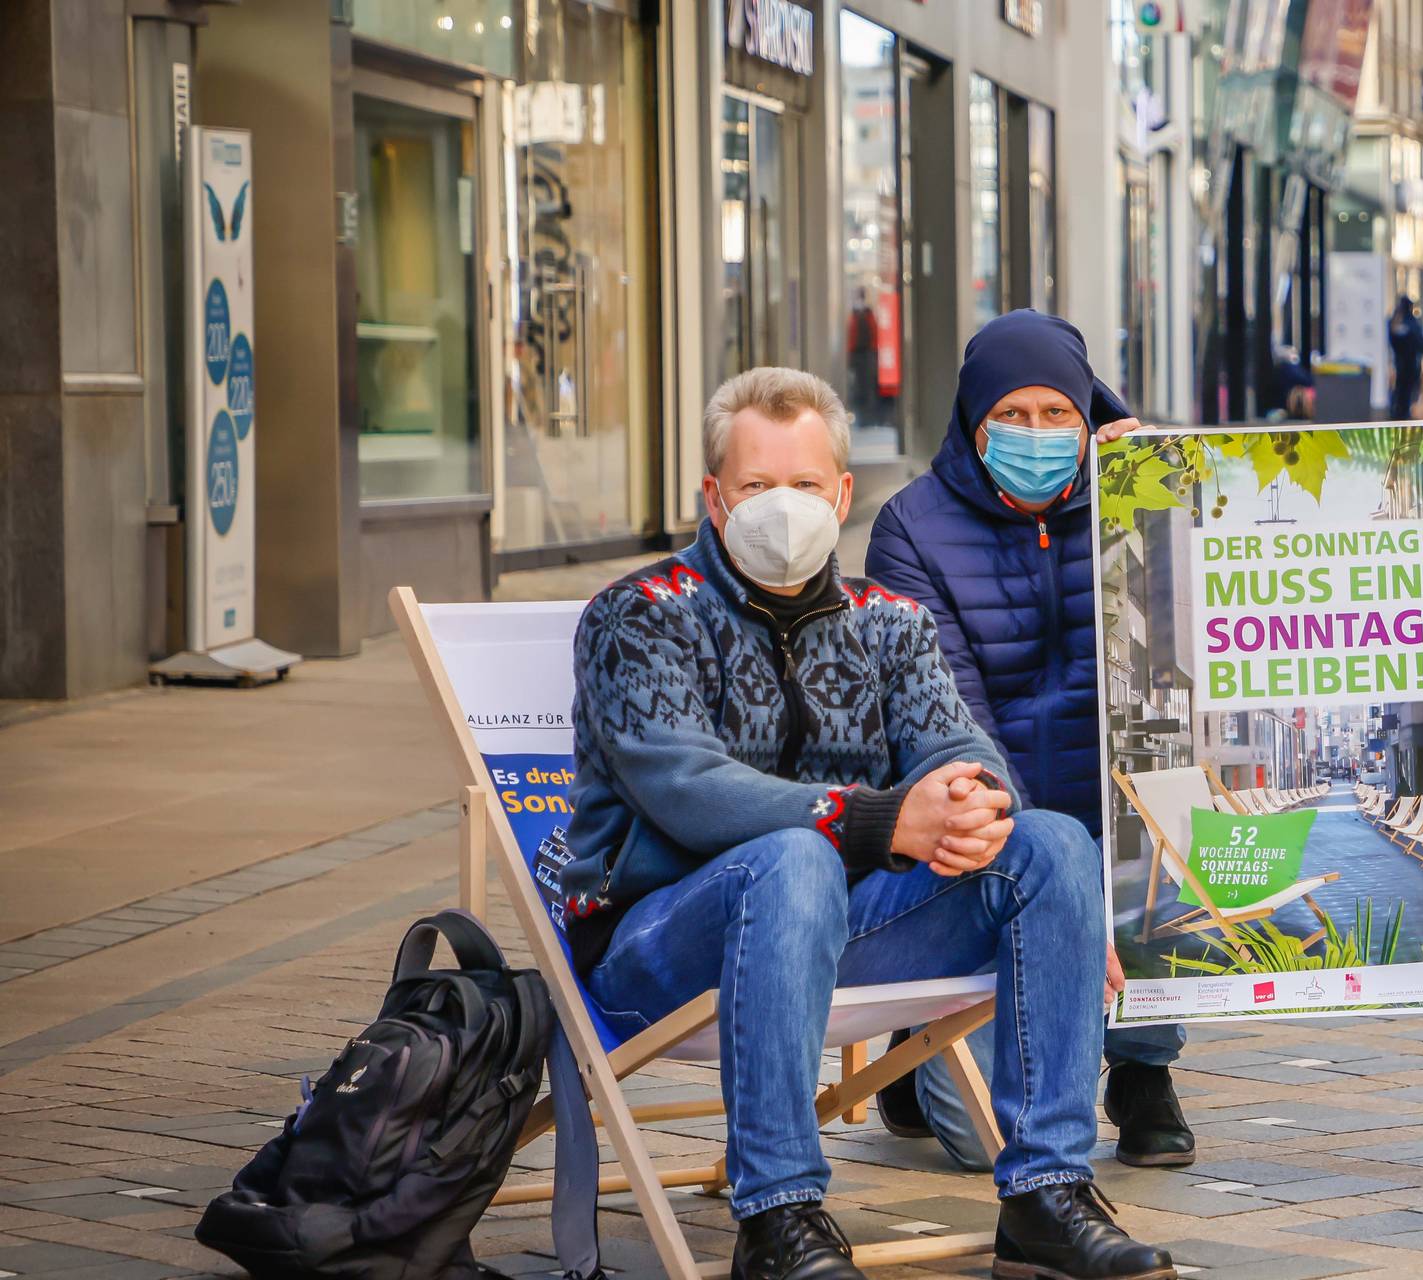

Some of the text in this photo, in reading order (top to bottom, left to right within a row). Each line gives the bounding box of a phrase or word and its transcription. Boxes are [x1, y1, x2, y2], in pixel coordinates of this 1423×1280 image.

[1203, 529, 1420, 561] DER SONNTAG
[1205, 564, 1422, 607] MUSS EIN
[1206, 609, 1423, 654] SONNTAG
[467, 712, 565, 725] ALLIANZ FÜR
[492, 769, 520, 785] Es
[502, 790, 576, 814] Son
[1199, 846, 1287, 860] WOCHEN OHNE
[1200, 860, 1274, 872] SONNTAGS-
[1208, 870, 1269, 886] ÖFFNUNG
